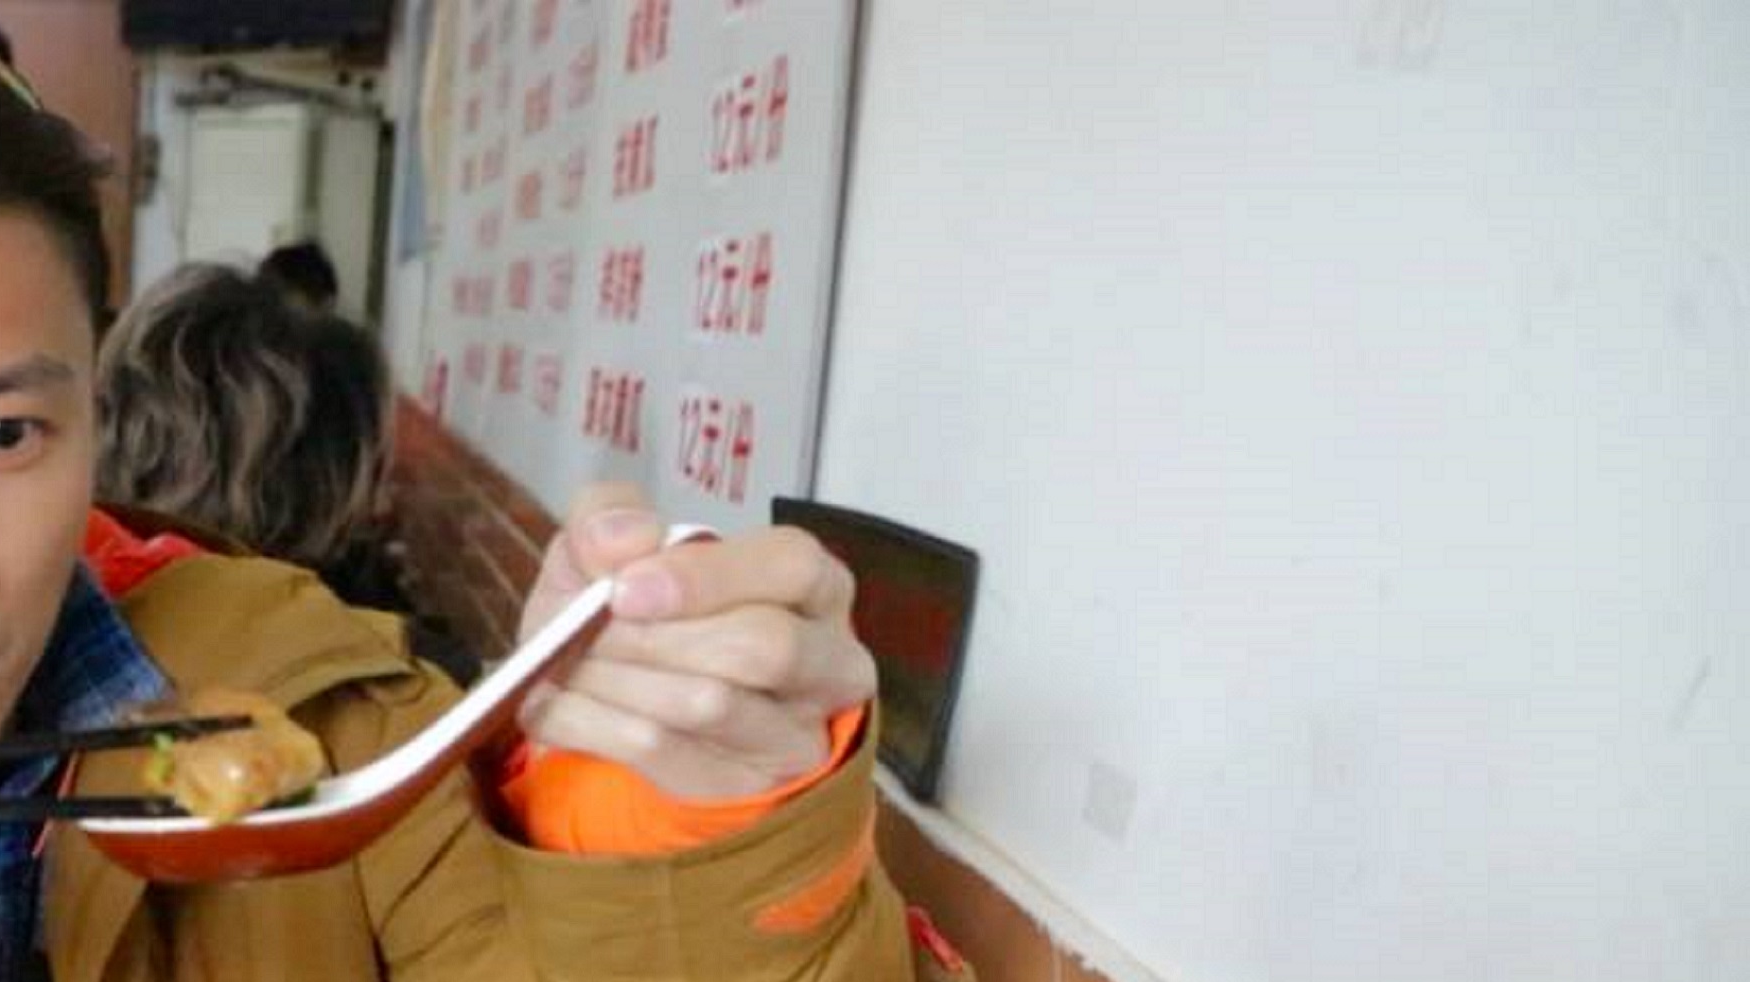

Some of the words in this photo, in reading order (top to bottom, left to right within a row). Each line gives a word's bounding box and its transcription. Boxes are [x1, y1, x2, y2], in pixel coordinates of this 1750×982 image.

[711, 54, 788, 174] 12元/份
[697, 232, 772, 334] 12元/份
[680, 398, 754, 504] 12元/份
